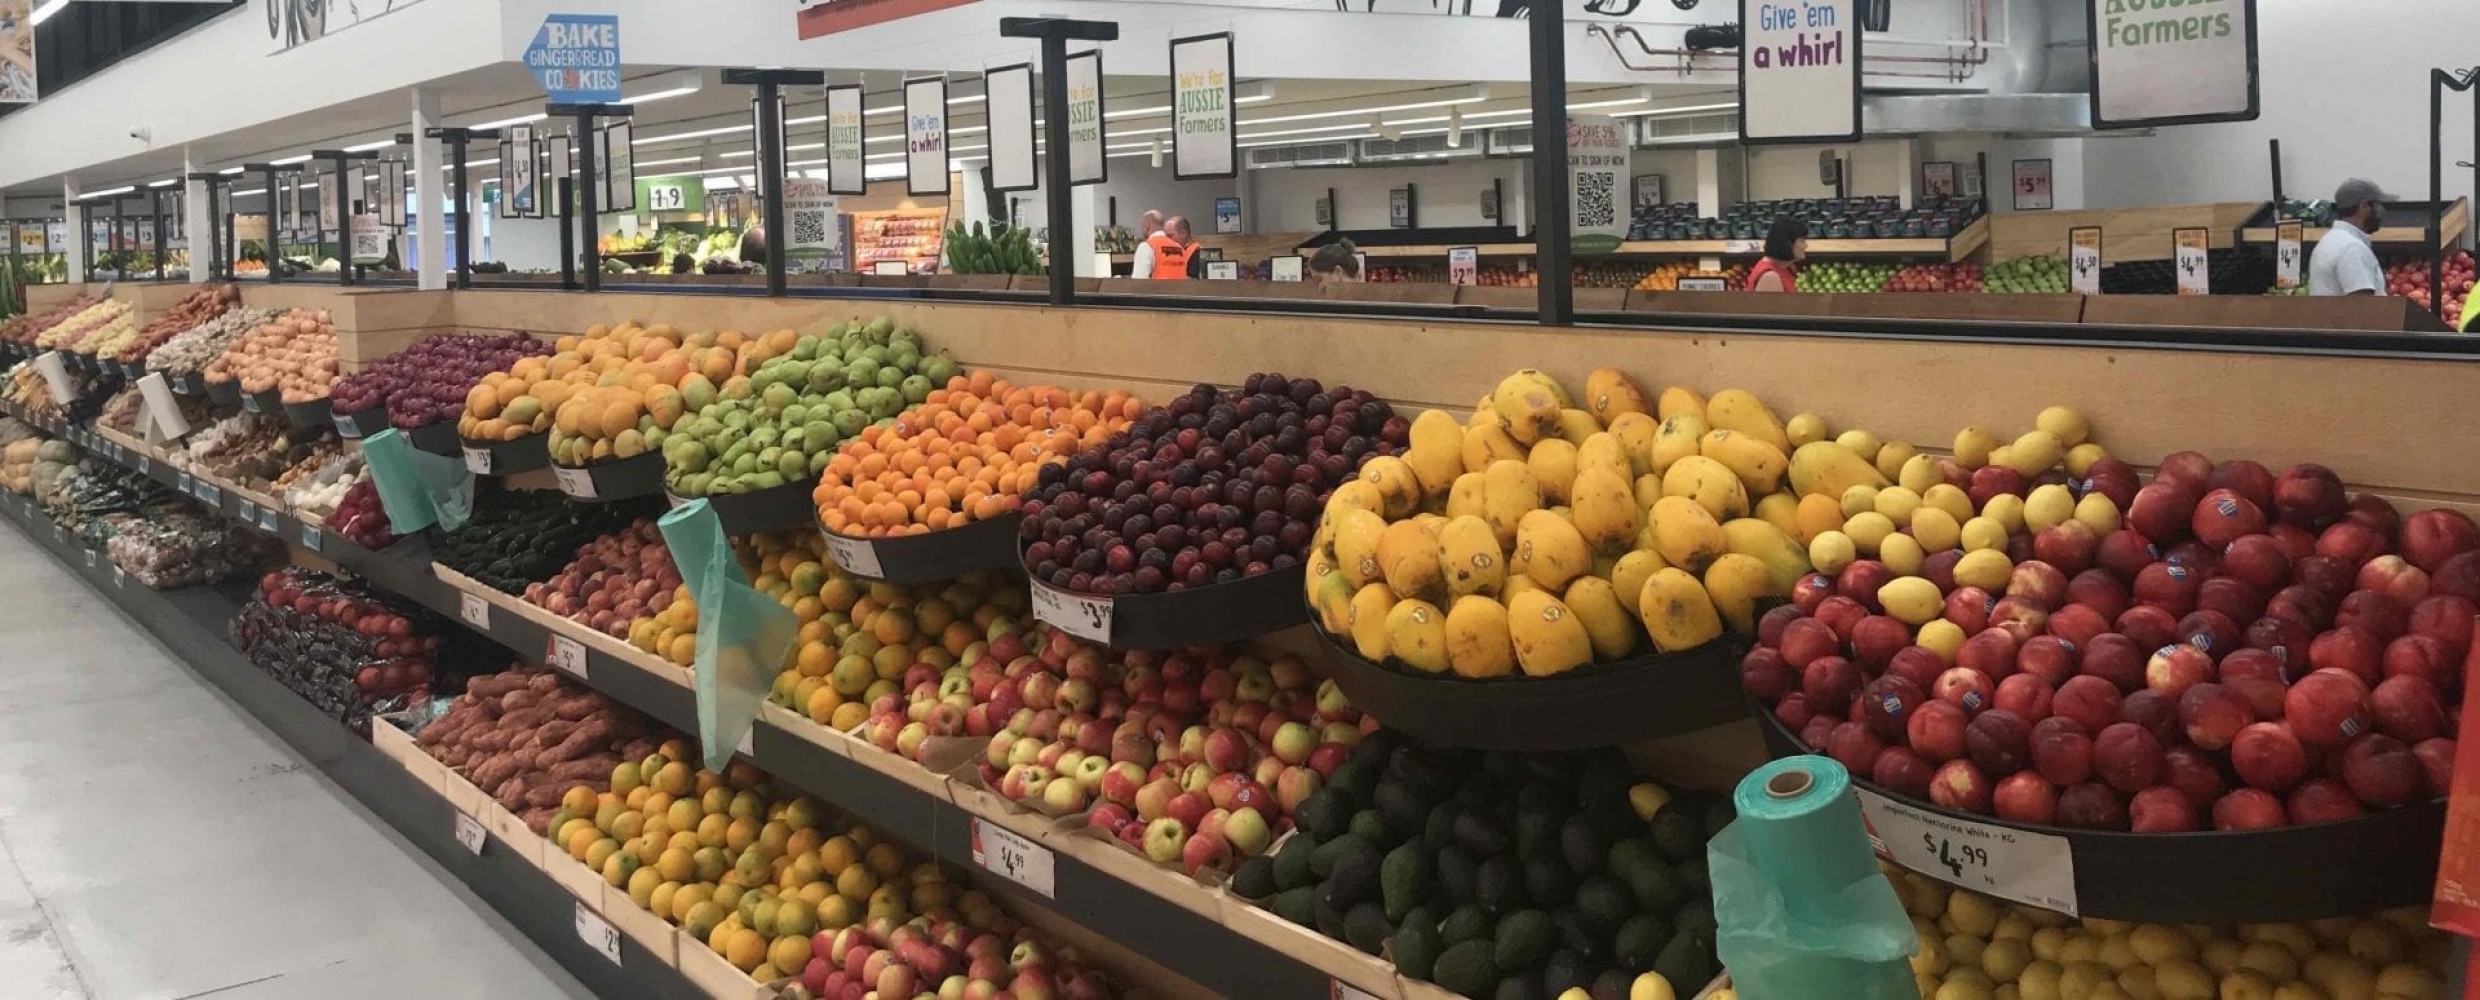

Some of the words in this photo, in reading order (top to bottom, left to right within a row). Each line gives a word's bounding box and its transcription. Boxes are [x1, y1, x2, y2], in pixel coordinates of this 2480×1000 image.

[1761, 4, 1796, 31] Give
[1803, 1, 1835, 28] 'em
[544, 22, 615, 49] BAKE
[2107, 13, 2231, 47] Farmers
[1754, 46, 1770, 68] a
[1778, 31, 1842, 67] whirl
[1180, 72, 1205, 88] We're
[1209, 69, 1223, 85] for
[1082, 84, 1094, 100] for
[1179, 87, 1224, 114] AUSSIE
[1069, 100, 1095, 125] SSIE
[1070, 127, 1096, 143] rmers
[1180, 115, 1225, 134] Farmers
[919, 132, 941, 152] whirl
[1965, 827, 1990, 838] White
